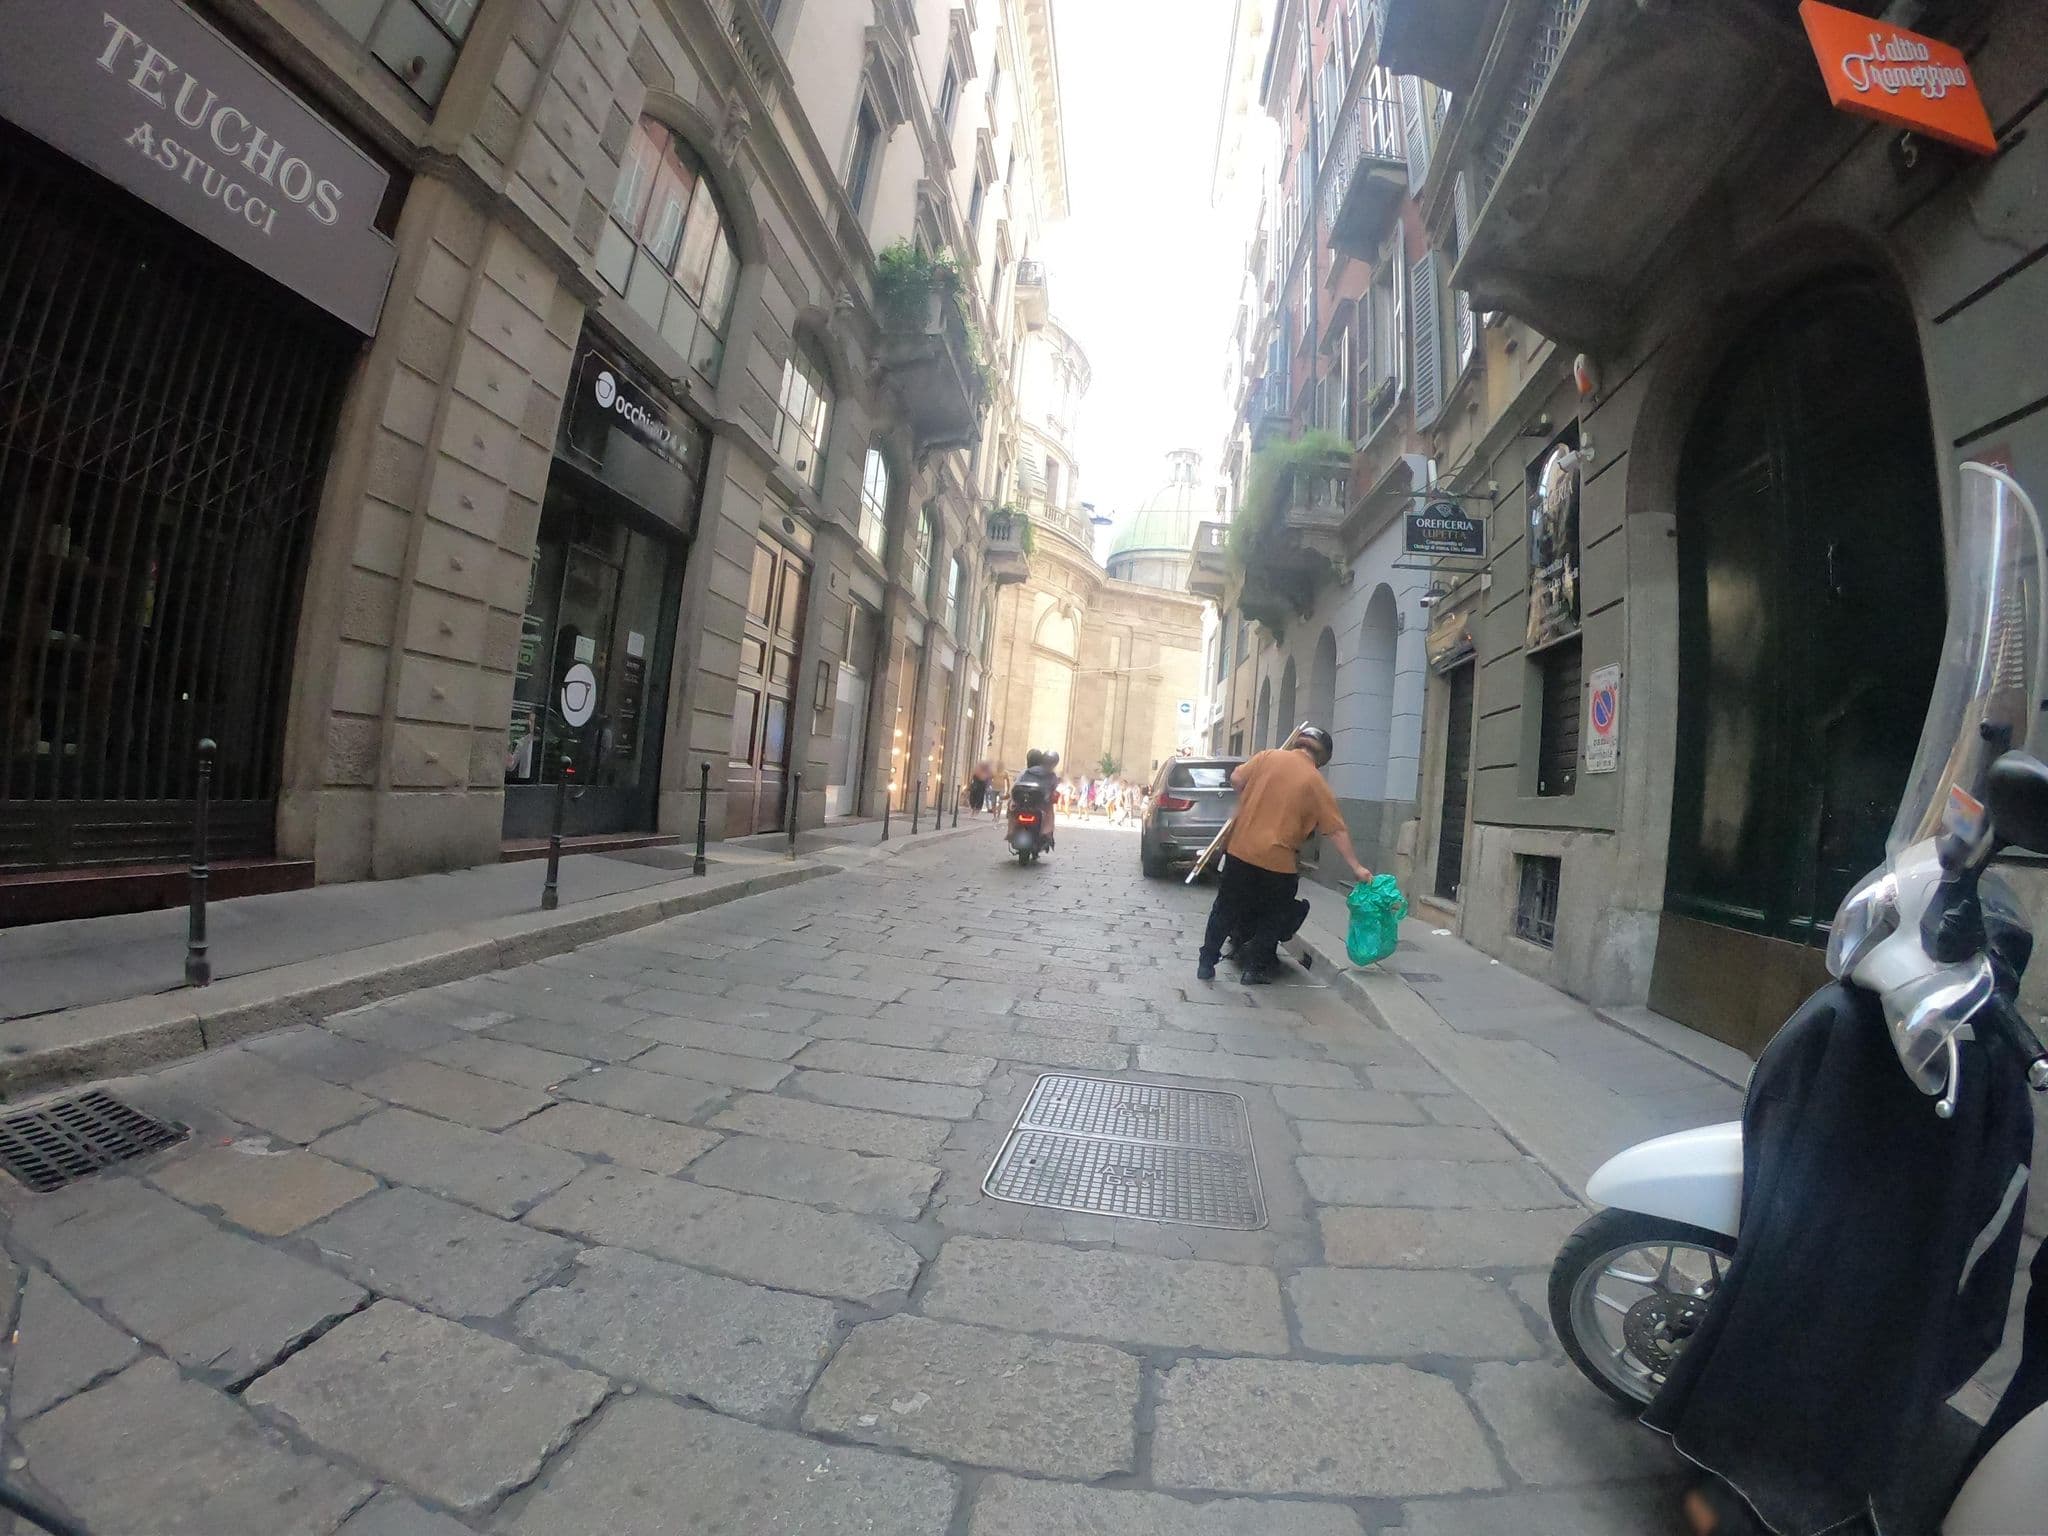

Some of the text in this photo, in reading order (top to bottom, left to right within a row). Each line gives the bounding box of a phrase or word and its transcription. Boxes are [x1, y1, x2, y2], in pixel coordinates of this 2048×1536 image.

[1841, 53, 1967, 98] Tramezzino
[95, 12, 345, 226] TEUCHOS
[1900, 131, 1919, 168] 5
[124, 121, 279, 236] ASTUCCI
[1415, 518, 1474, 531] OREFICERIA
